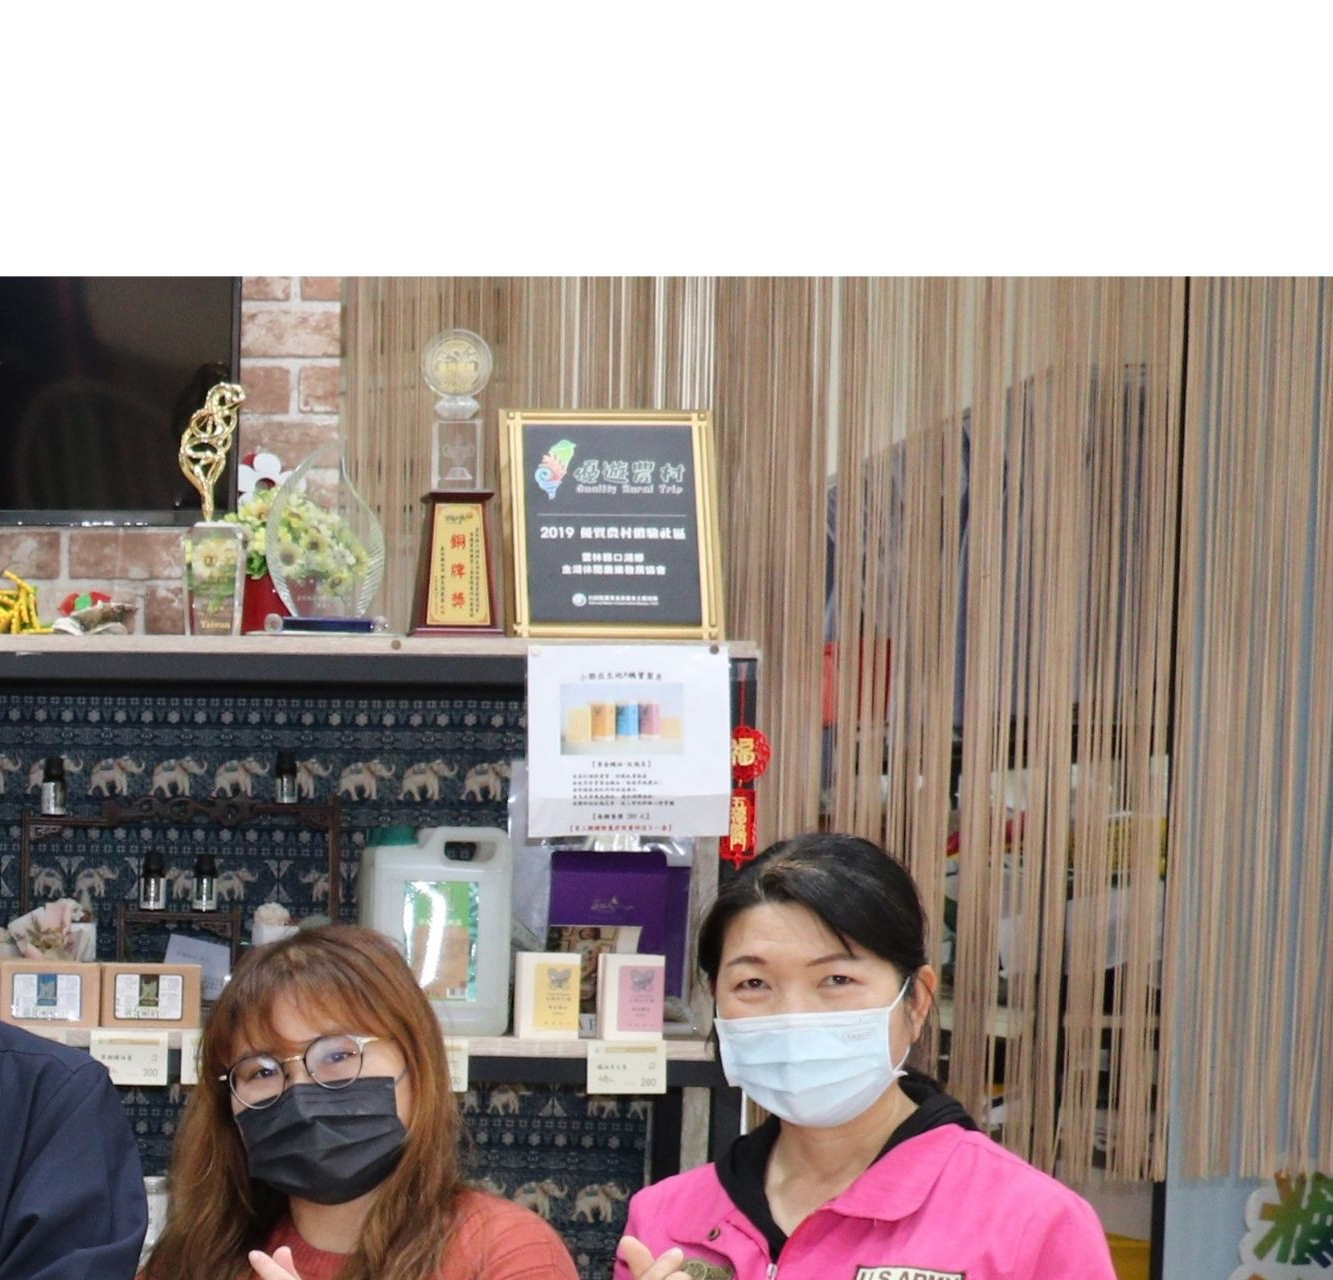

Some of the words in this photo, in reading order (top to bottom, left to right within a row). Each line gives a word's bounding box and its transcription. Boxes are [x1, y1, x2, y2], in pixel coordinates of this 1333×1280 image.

[573, 459, 686, 484] 優遊農村
[575, 484, 618, 495] Quality
[621, 484, 655, 494] Rural
[658, 485, 684, 495] Trip
[539, 526, 575, 539] 2019
[201, 619, 231, 630] Taiwan
